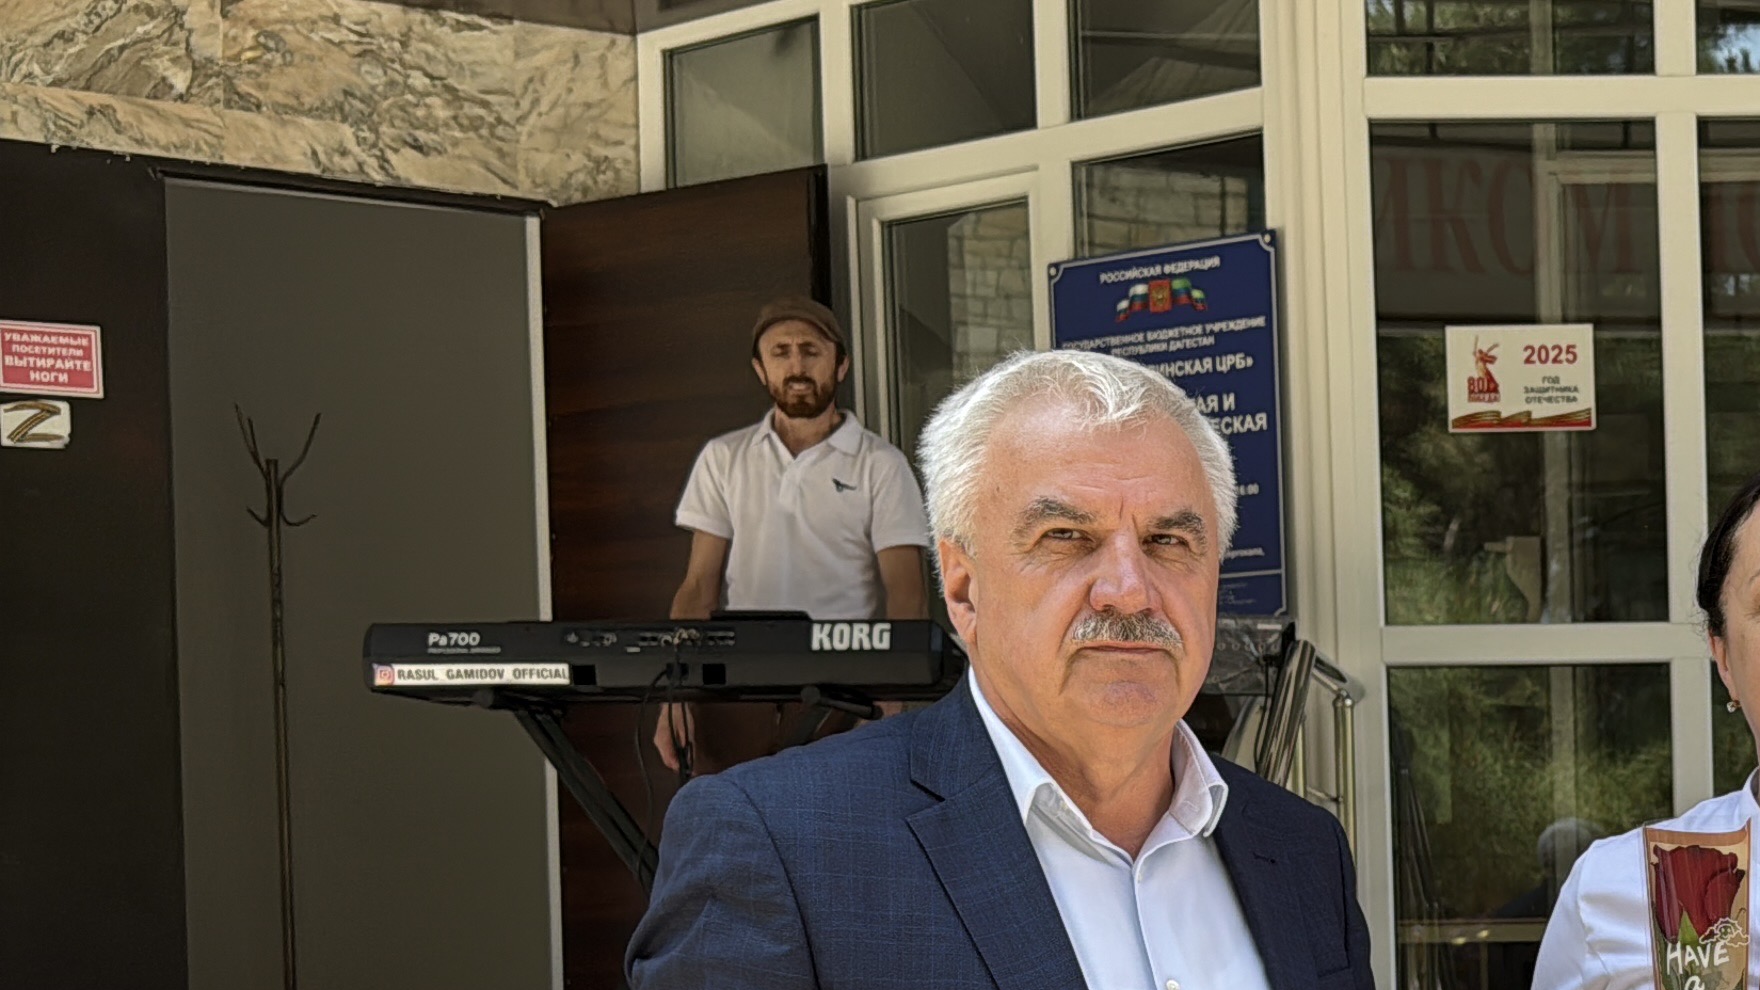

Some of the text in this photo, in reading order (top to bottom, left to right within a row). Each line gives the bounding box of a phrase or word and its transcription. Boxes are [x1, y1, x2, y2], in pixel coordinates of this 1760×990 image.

[1100, 255, 1221, 284] РОССИЙСКАЯ ФЕДЕРАЦИЯ
[1205, 316, 1266, 333] УЧРЕЖДЕНИЕ
[4, 332, 89, 346] УВАЖАЕМЫЕ
[1169, 335, 1215, 352] ДАГЕСТАН
[12, 344, 84, 356] ПОСЕТИТЕЛИ
[1523, 344, 1578, 365] 2025
[4, 355, 92, 371] ВЫТИРАЙТЕ
[29, 371, 69, 383] НОГИ
[1542, 376, 1560, 385] ГОД
[1524, 386, 1580, 394] ЗАЩИТНИКА
[1223, 392, 1235, 411] И
[1524, 396, 1578, 404] ОТЕЧЕСТВА
[428, 632, 481, 647] Pa700
[811, 622, 891, 651] KORG
[1666, 940, 1730, 975] HAVE
